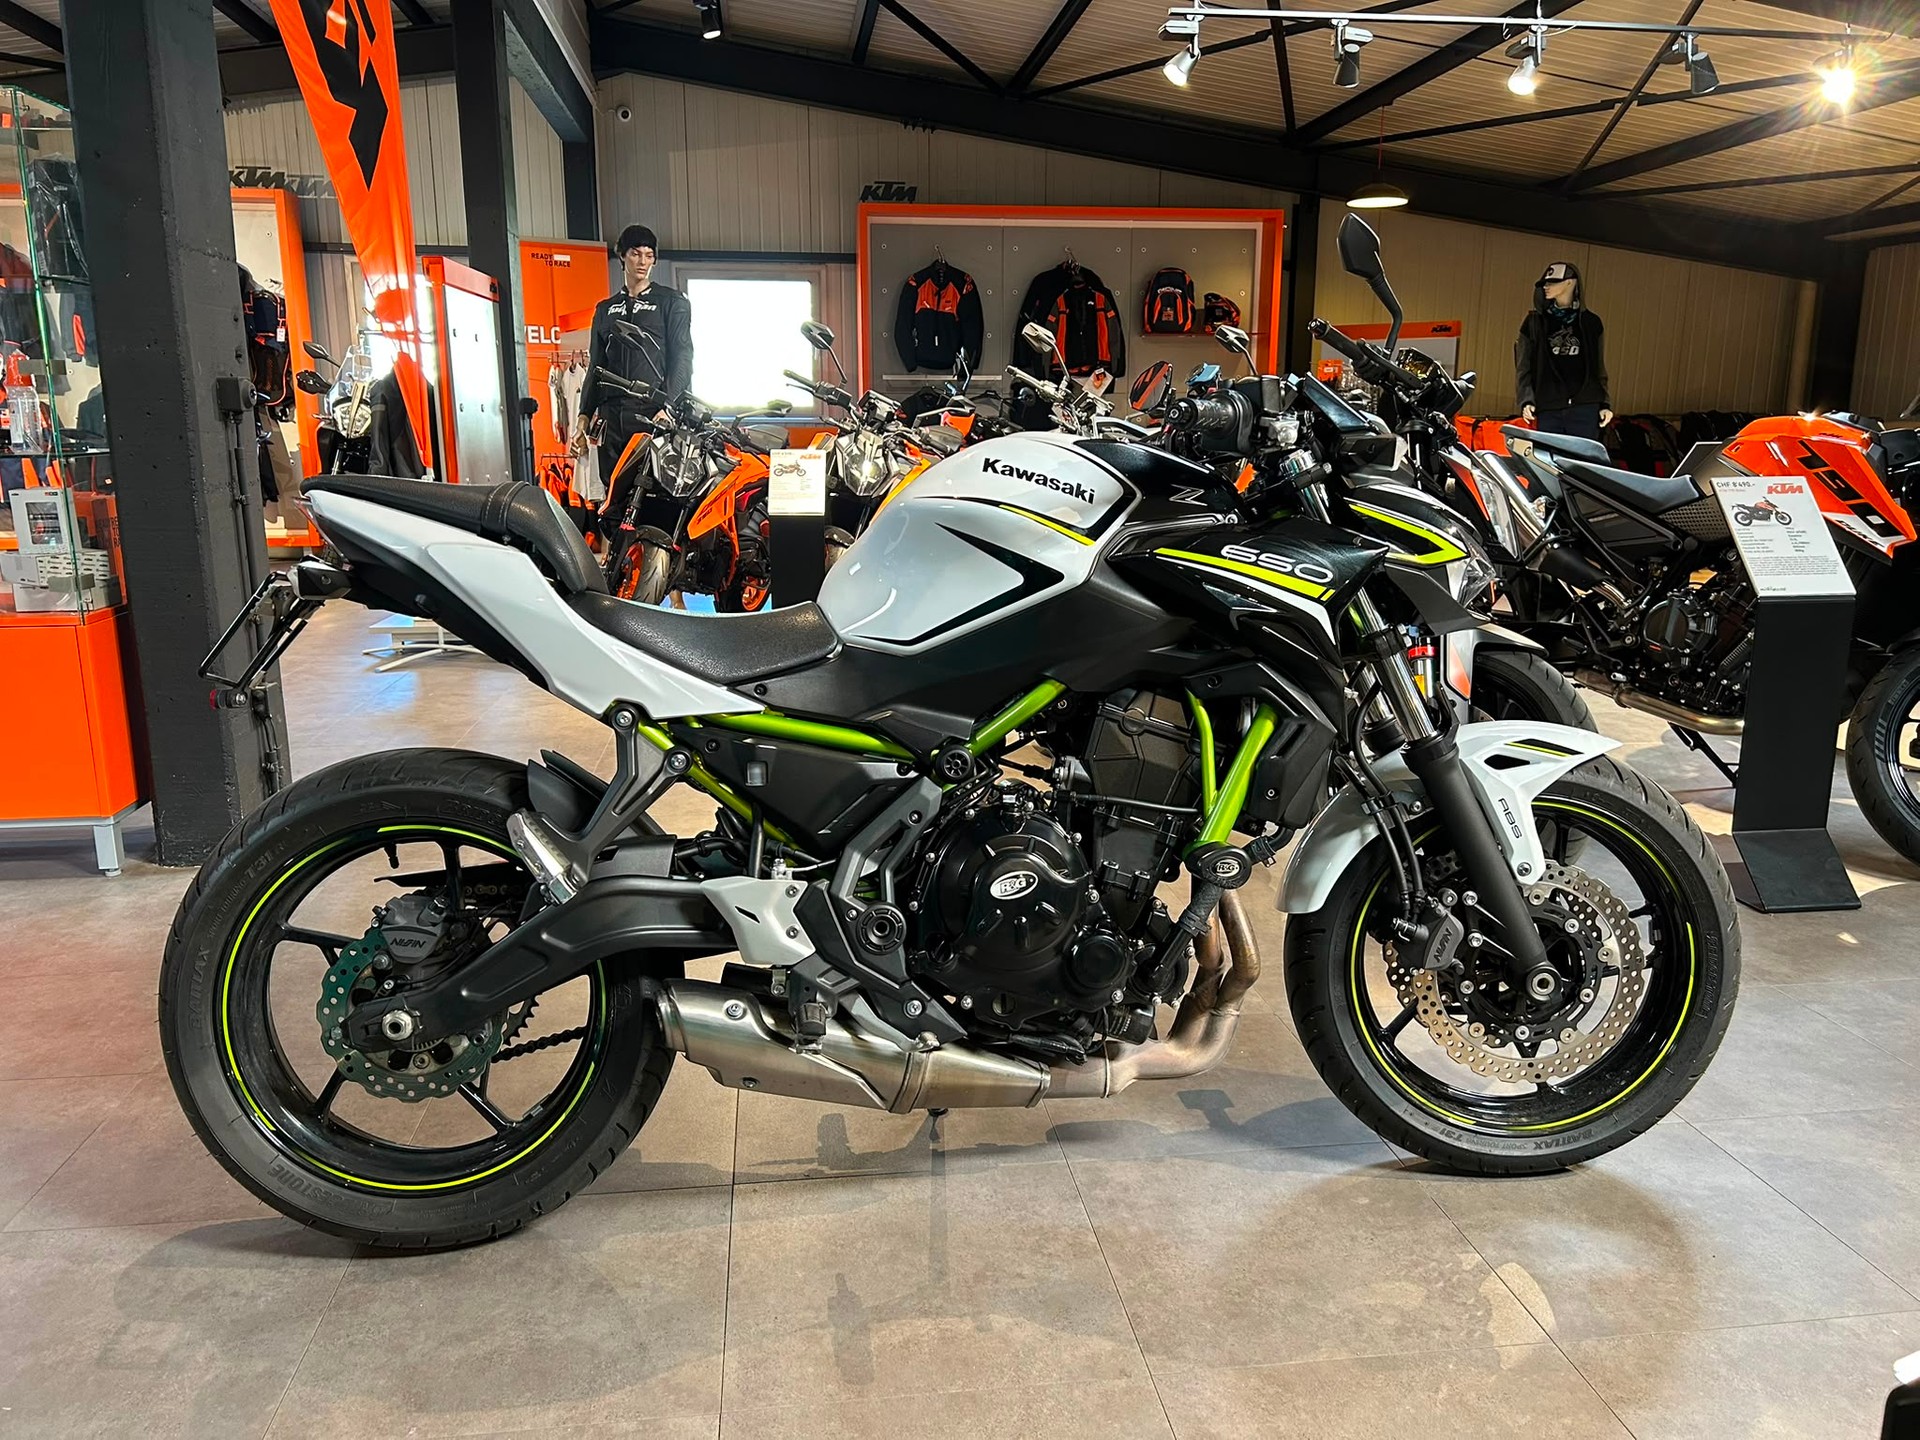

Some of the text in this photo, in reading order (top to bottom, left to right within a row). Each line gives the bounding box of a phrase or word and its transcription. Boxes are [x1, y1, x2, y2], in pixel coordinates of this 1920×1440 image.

[229, 166, 285, 188] KTM
[860, 181, 918, 201] KTM
[531, 252, 554, 260] READY
[524, 325, 562, 345] ELC
[982, 457, 1096, 505] Kawasaki
[1716, 481, 1731, 489] CHF
[1767, 482, 1804, 495] KTM
[1220, 544, 1334, 584] 650
[1498, 797, 1523, 839] ABS
